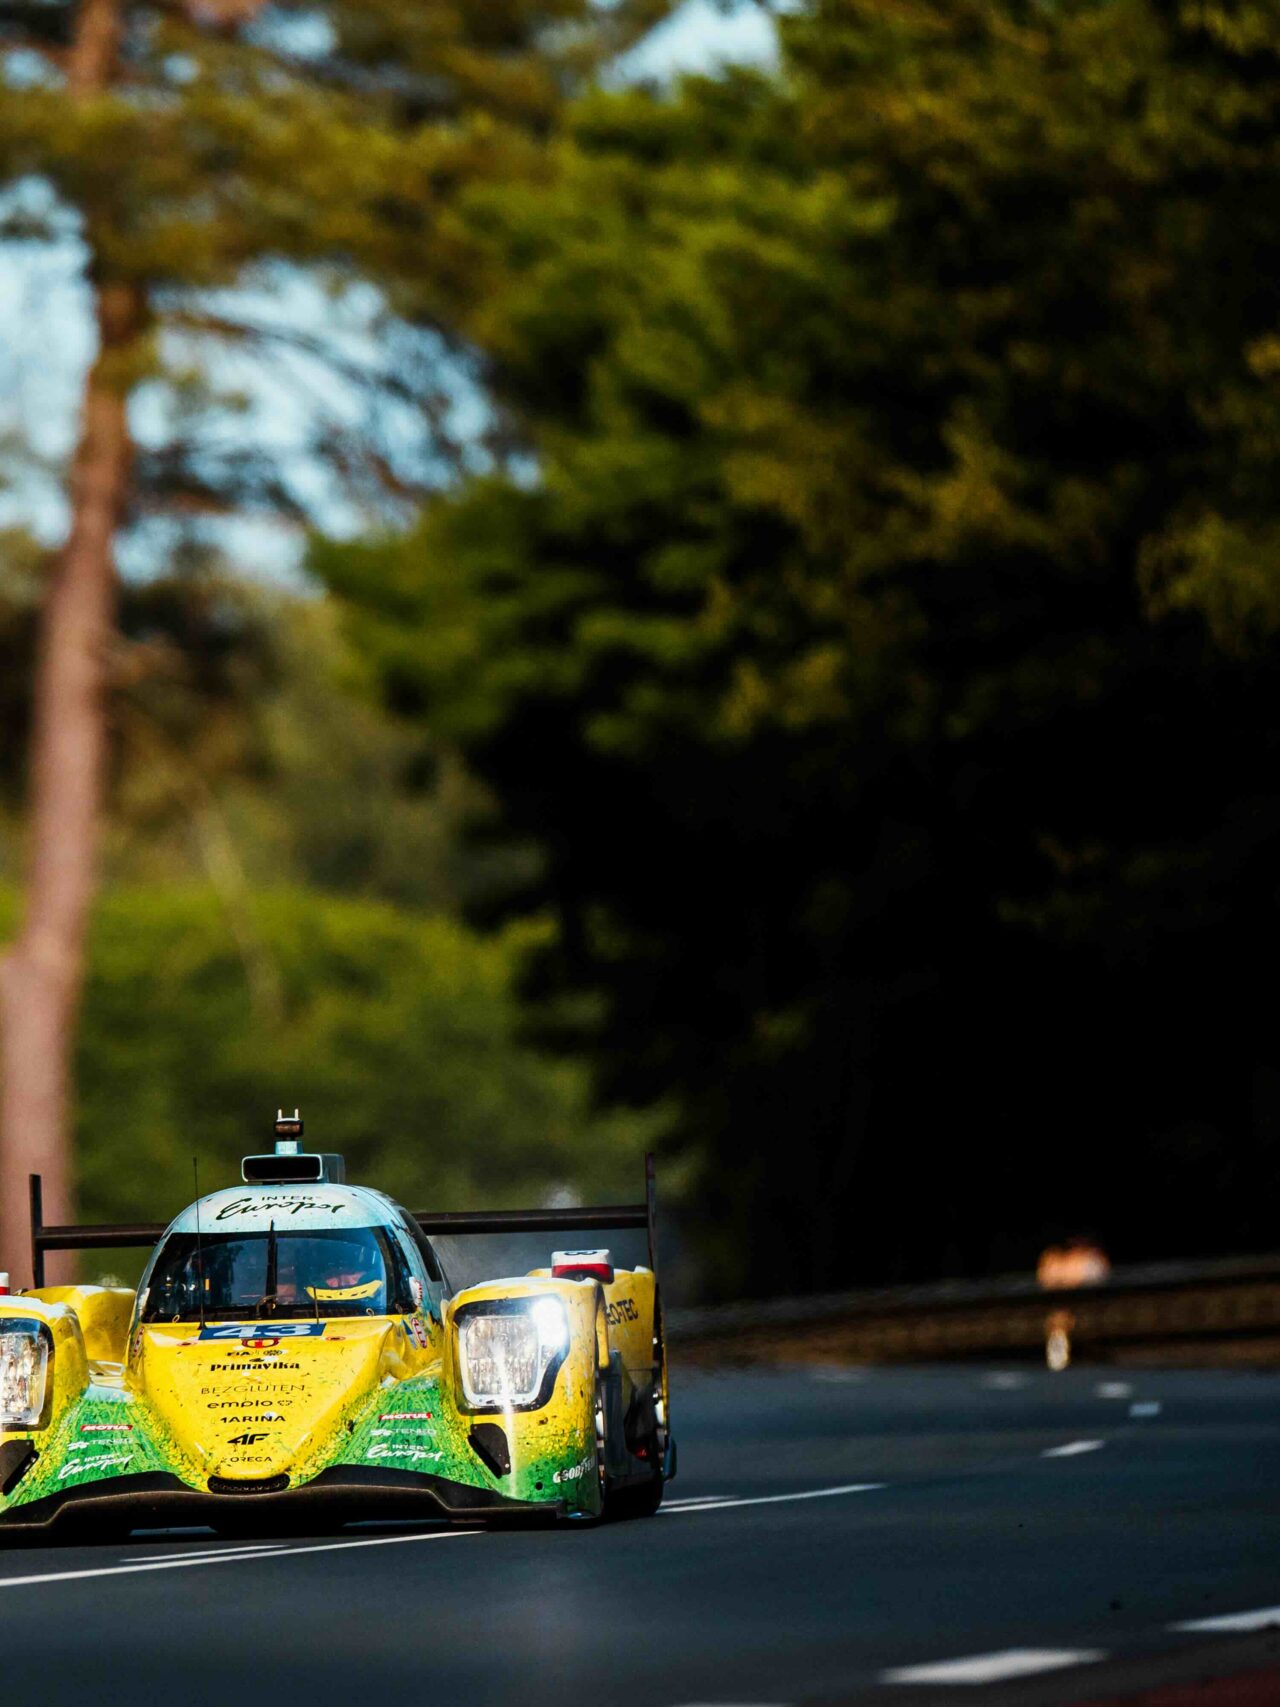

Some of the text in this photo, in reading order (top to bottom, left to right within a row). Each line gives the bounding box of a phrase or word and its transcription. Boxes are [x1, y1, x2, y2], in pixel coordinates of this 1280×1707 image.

[213, 1324, 312, 1338] 43
[207, 1400, 273, 1409] emplo
[227, 1433, 270, 1446] 4F
